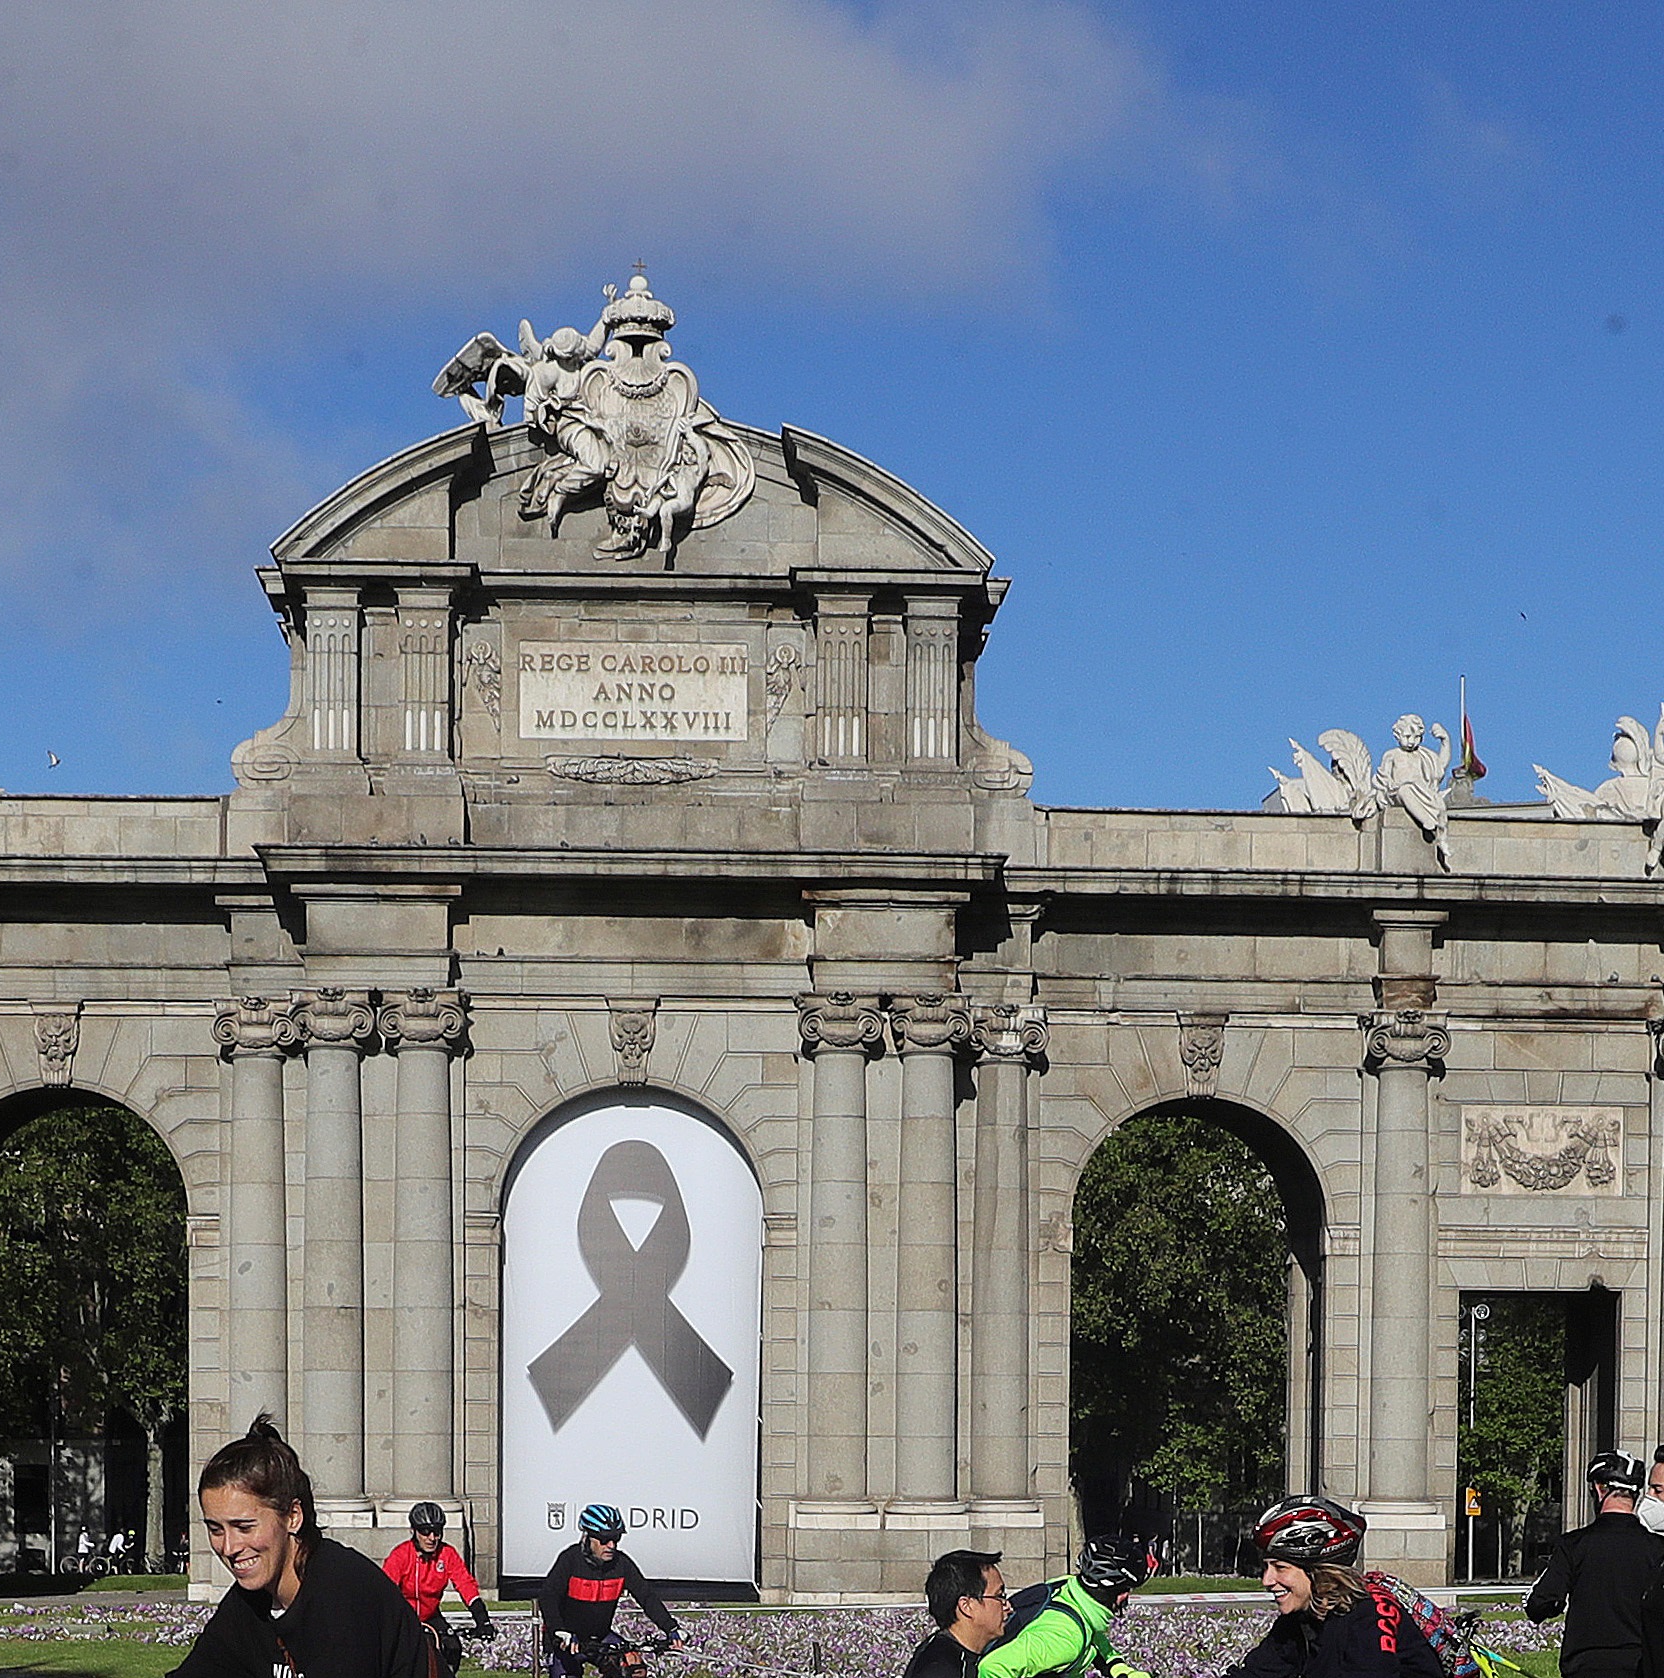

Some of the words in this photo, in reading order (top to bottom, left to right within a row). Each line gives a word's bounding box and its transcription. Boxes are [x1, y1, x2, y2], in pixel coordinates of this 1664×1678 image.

[520, 652, 592, 674] REGE
[601, 653, 712, 676] CAROLO
[718, 655, 749, 676] III
[591, 681, 677, 702] ANNO
[534, 708, 733, 731] MDCCLXXVIII
[620, 1506, 700, 1530] DRID
[1365, 1583, 1403, 1654] BOST
